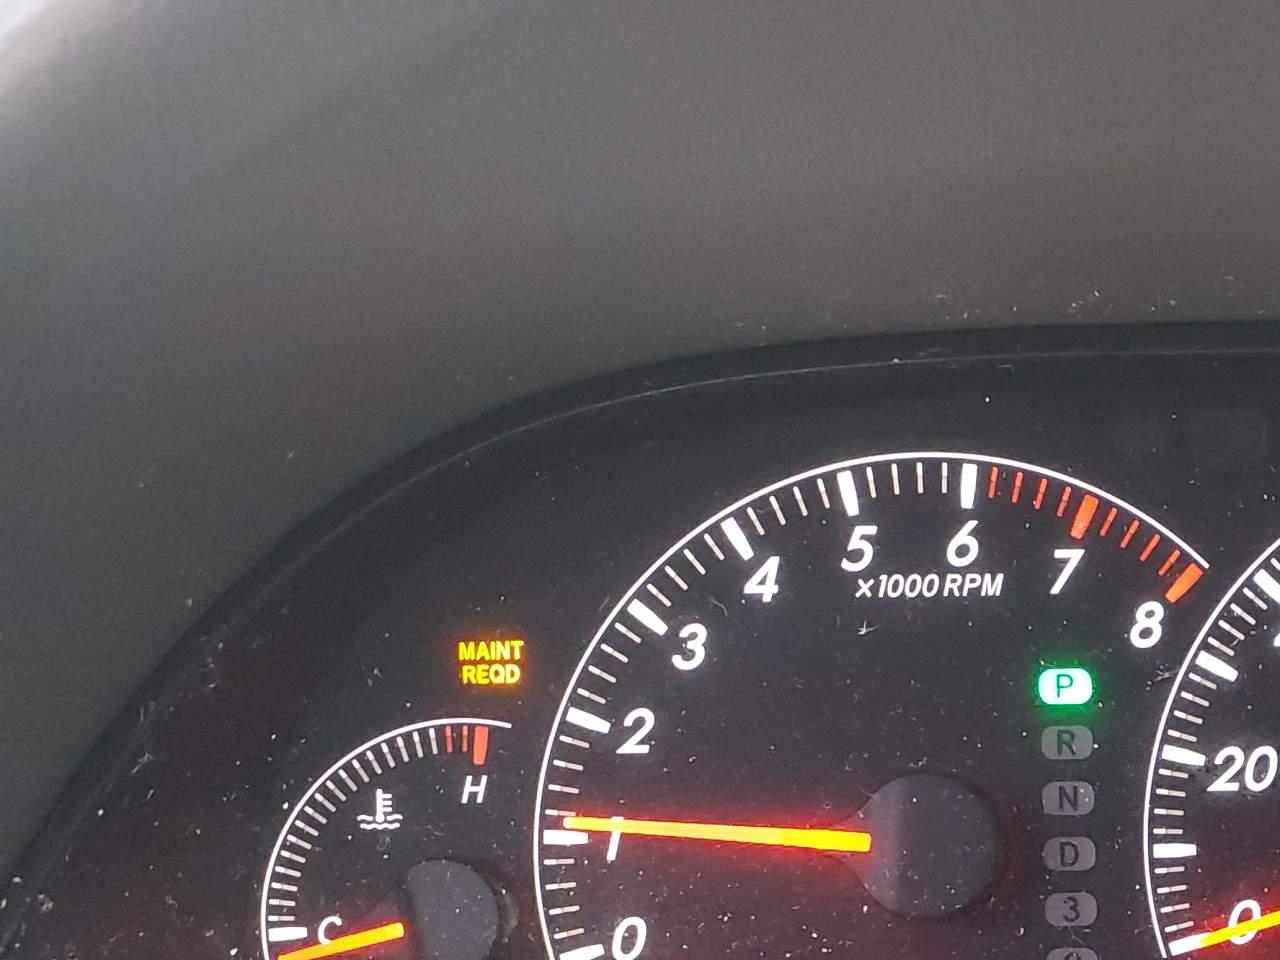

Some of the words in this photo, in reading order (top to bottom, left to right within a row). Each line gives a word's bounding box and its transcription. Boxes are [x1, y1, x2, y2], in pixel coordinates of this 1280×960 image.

[840, 525, 877, 572] 5
[946, 521, 979, 567] 6
[743, 557, 780, 602] 4
[942, 573, 1003, 598] RPM
[1050, 548, 1085, 595] 7
[1129, 600, 1163, 648] 8
[458, 640, 524, 661] MAINT
[672, 624, 708, 670] 3
[462, 664, 521, 684] REQD
[1054, 673, 1073, 696] P
[615, 708, 655, 754] 2
[1056, 730, 1076, 754] R
[1206, 746, 1278, 792] 20
[461, 775, 487, 803] H
[1057, 786, 1078, 809] N
[1059, 842, 1079, 866] D
[1060, 897, 1080, 921] 3
[1228, 899, 1262, 945] 0
